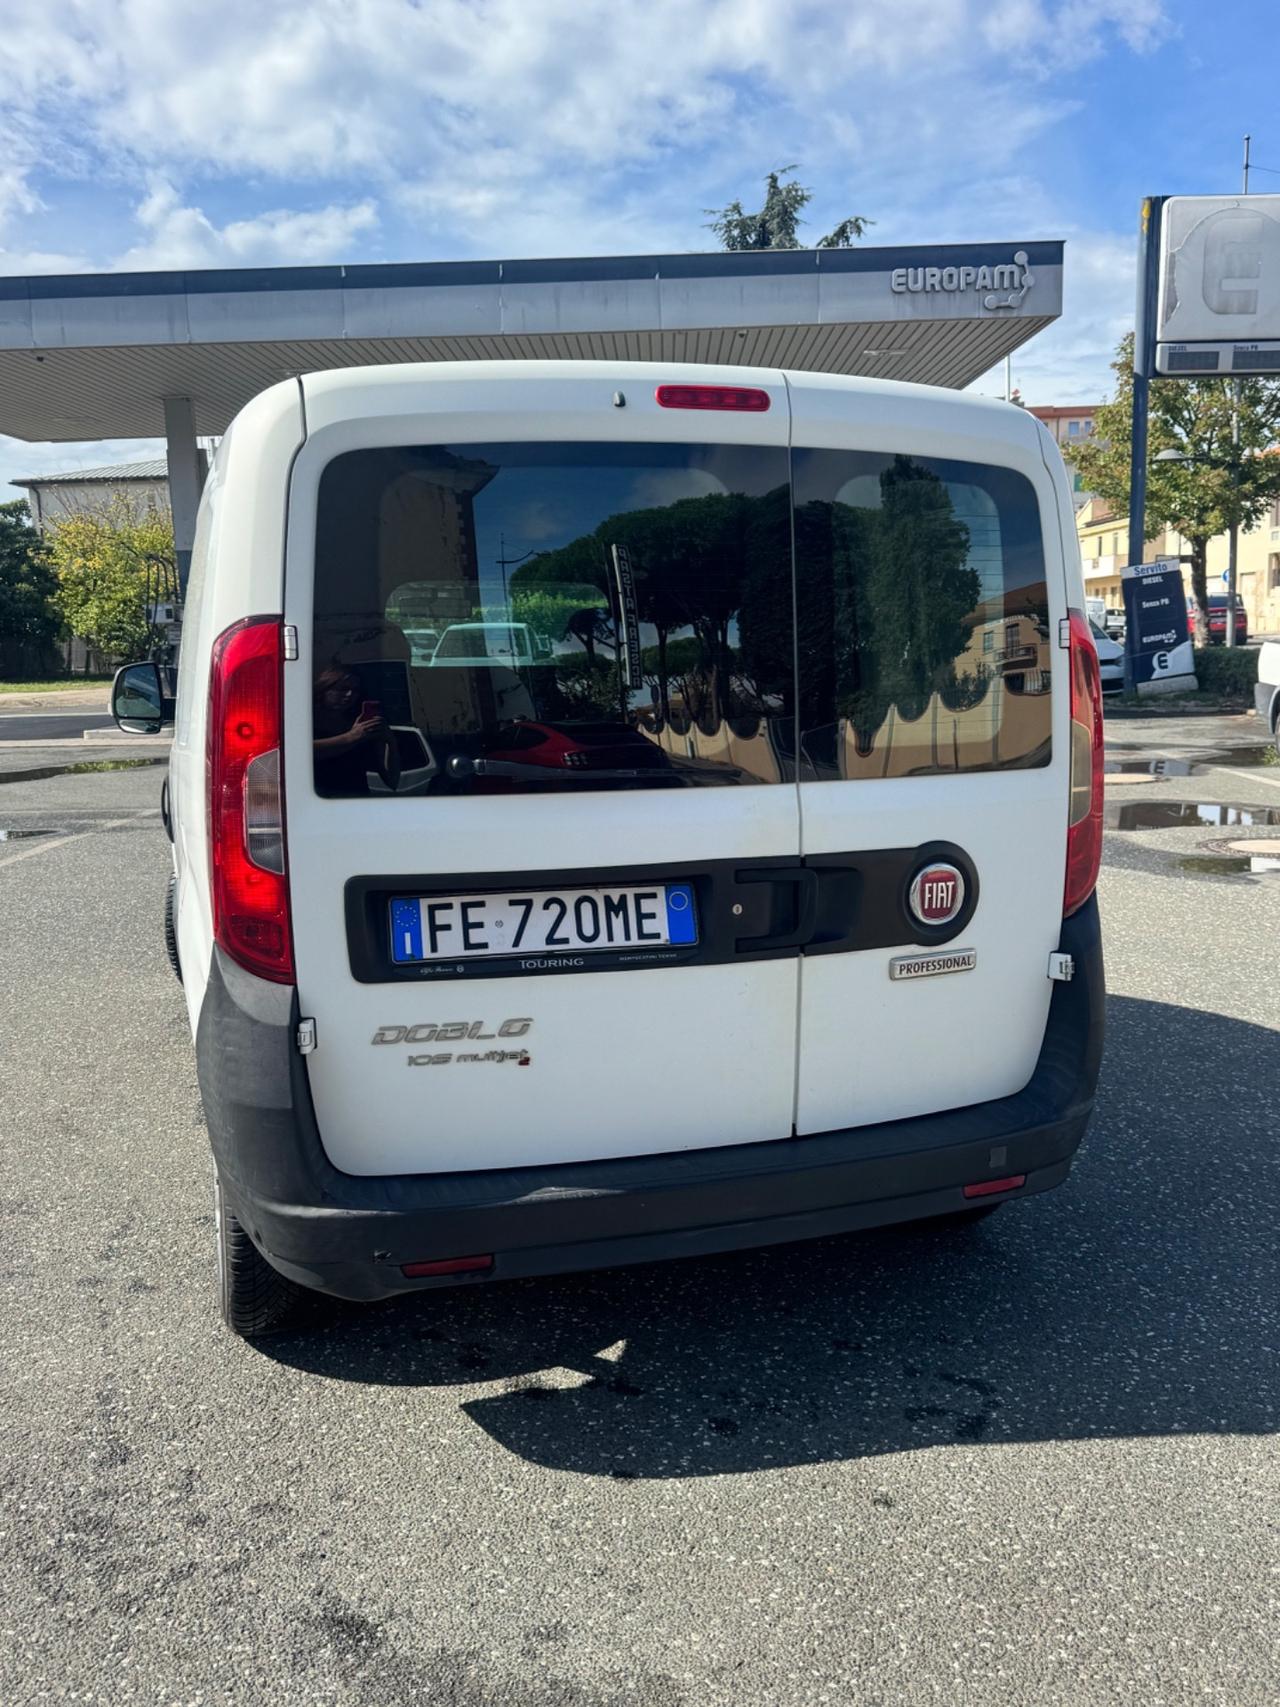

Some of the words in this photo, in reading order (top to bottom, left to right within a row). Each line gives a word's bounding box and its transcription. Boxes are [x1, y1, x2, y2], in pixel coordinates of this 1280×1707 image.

[891, 264, 1020, 293] EUROPAM
[1134, 562, 1168, 576] Servito
[1142, 576, 1164, 585] DIESEL
[1142, 600, 1160, 609] Senza
[1157, 653, 1169, 669] E
[925, 882, 955, 909] FIAT
[427, 900, 489, 954] FE
[508, 892, 661, 948] 720ME
[519, 957, 585, 970] TOURING
[899, 957, 972, 974] PROFESSIONAL
